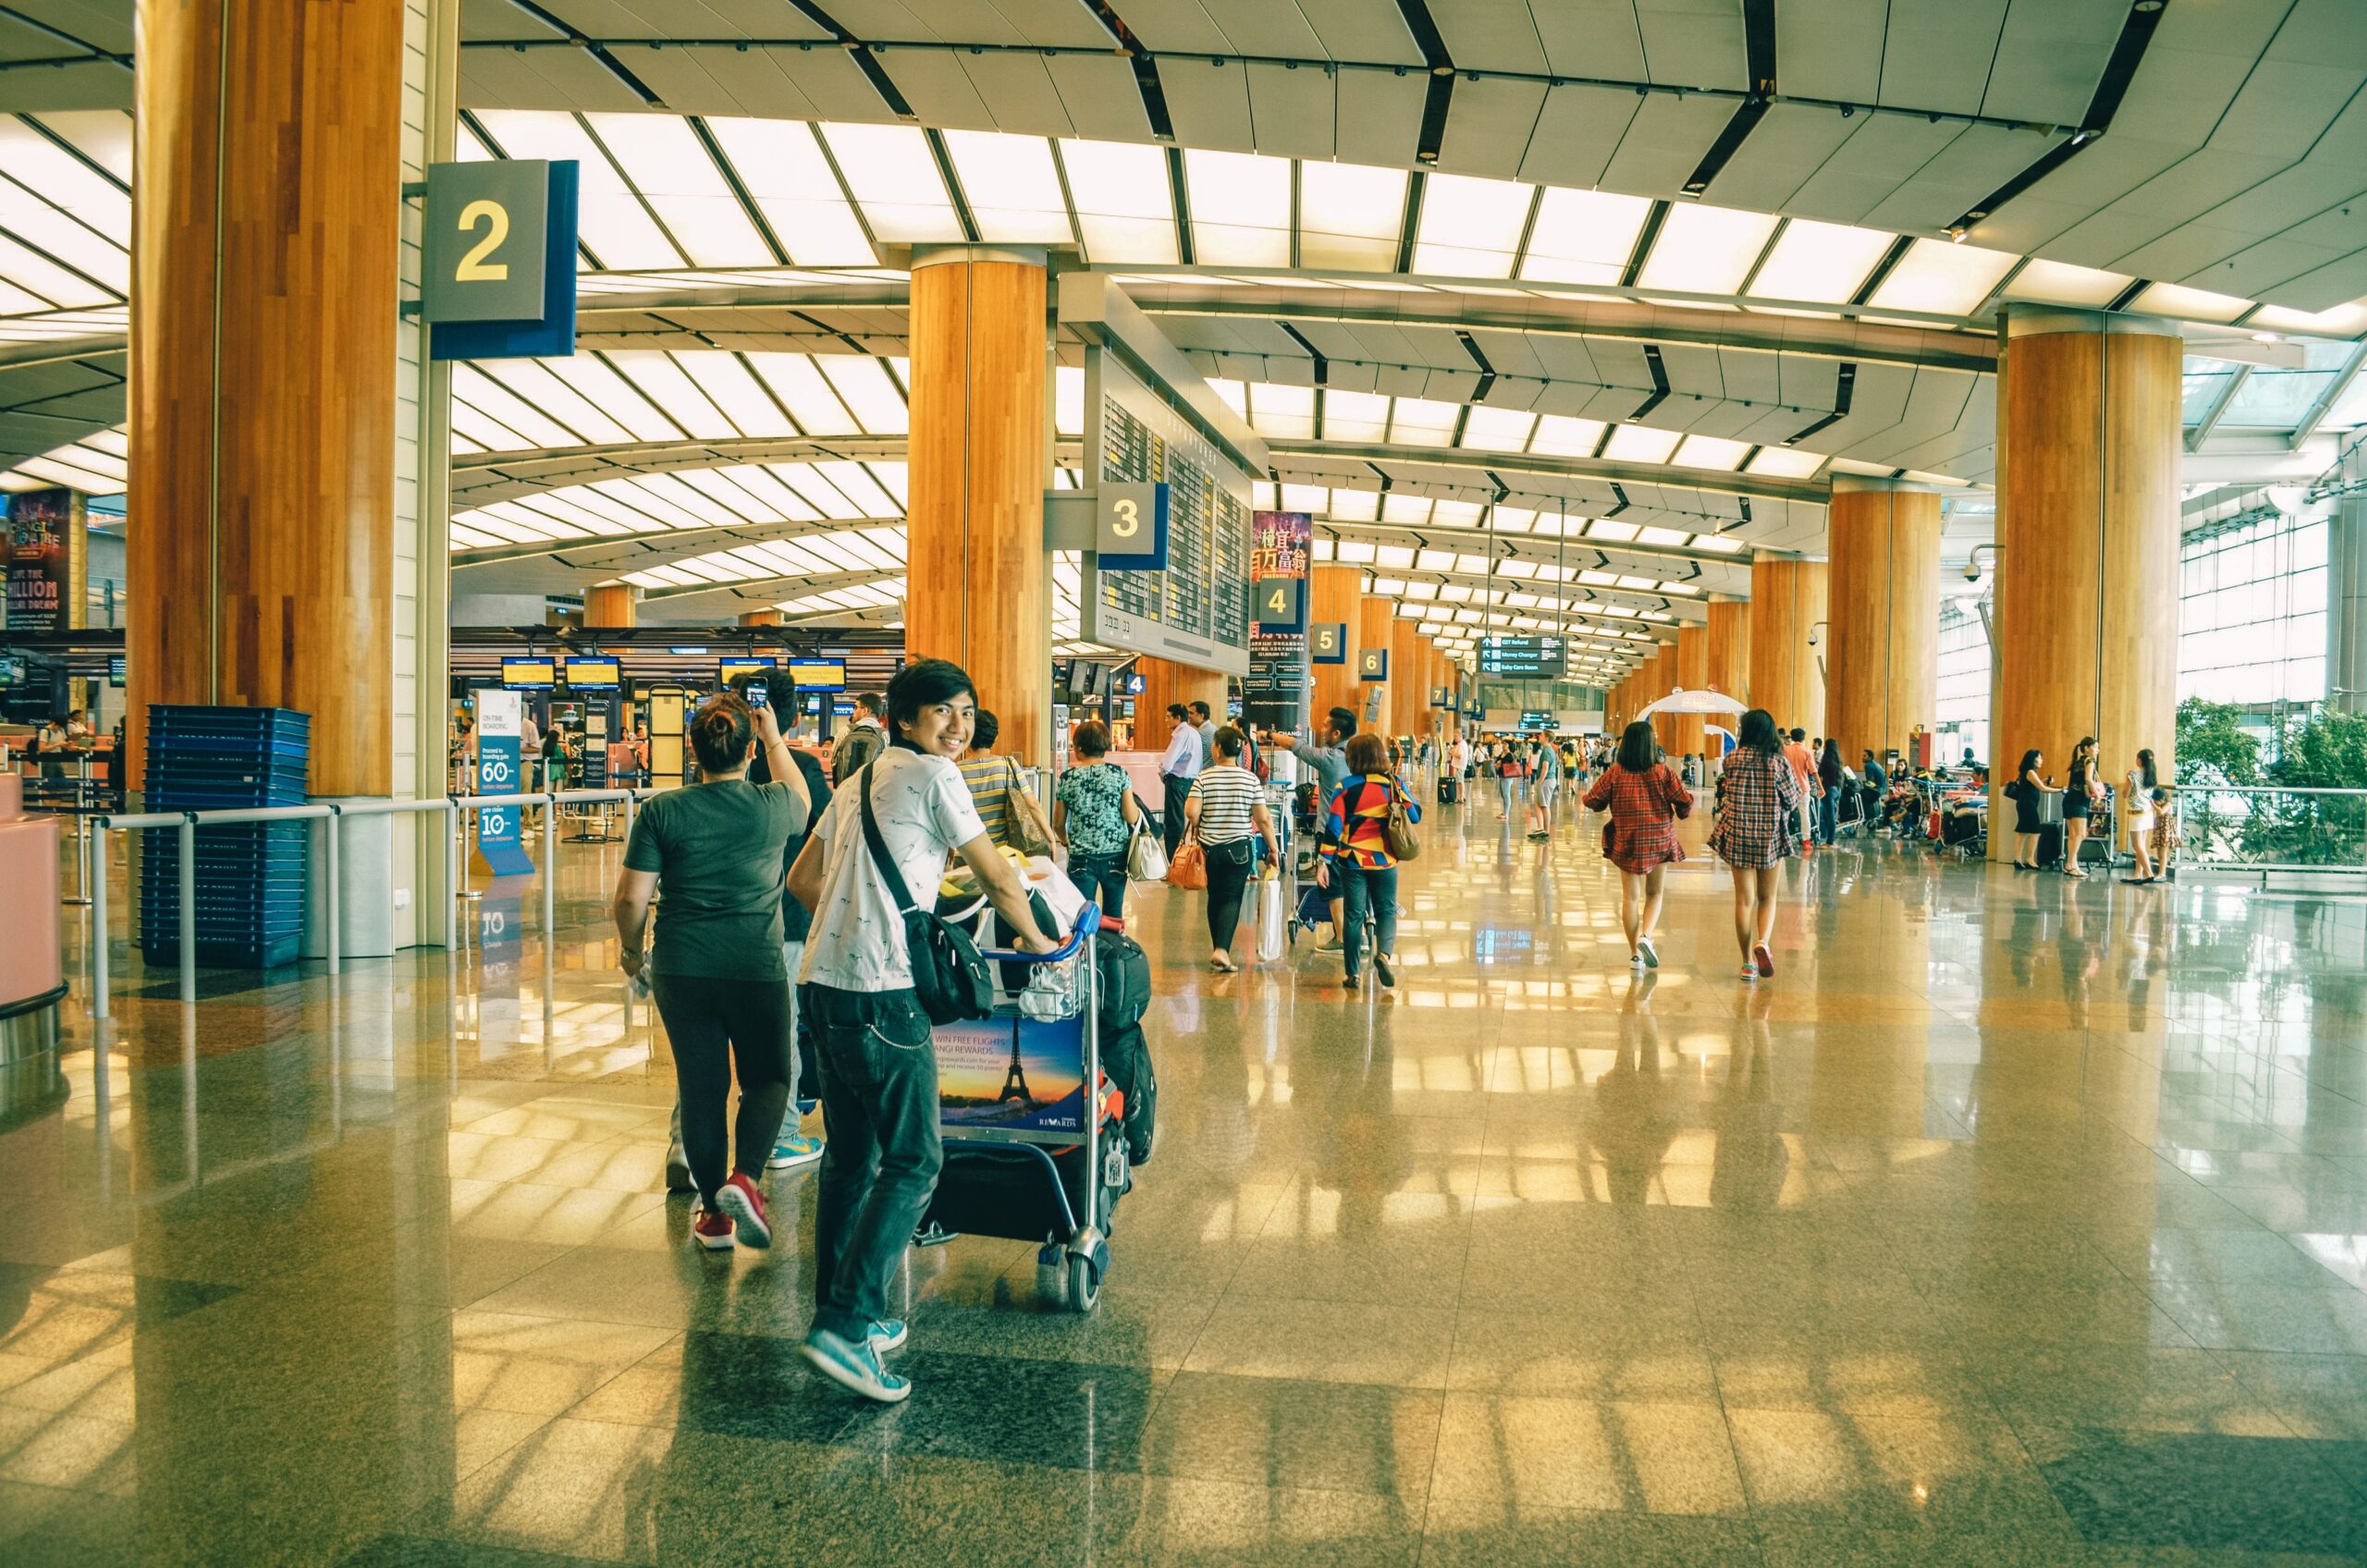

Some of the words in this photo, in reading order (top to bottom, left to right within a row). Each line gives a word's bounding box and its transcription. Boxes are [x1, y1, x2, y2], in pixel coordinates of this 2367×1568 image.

[456, 200, 509, 281] 2
[1167, 413, 1217, 466] DEPARTURES
[1112, 499, 1138, 537] 3
[28, 570, 43, 579] THE
[28, 600, 58, 610] DREAM
[1269, 588, 1286, 614] 4
[1319, 631, 1332, 649] 5
[1366, 655, 1377, 670] 6
[1130, 676, 1143, 692] 4
[1434, 690, 1441, 700] 7
[1447, 696, 1453, 704] 8
[482, 762, 508, 782] 60
[482, 815, 505, 835] 10
[953, 1035, 971, 1045] FREE
[974, 1036, 1005, 1046] FLIGHTS
[955, 1046, 994, 1055] REWARDS
[1039, 1118, 1076, 1127] REWARDS
